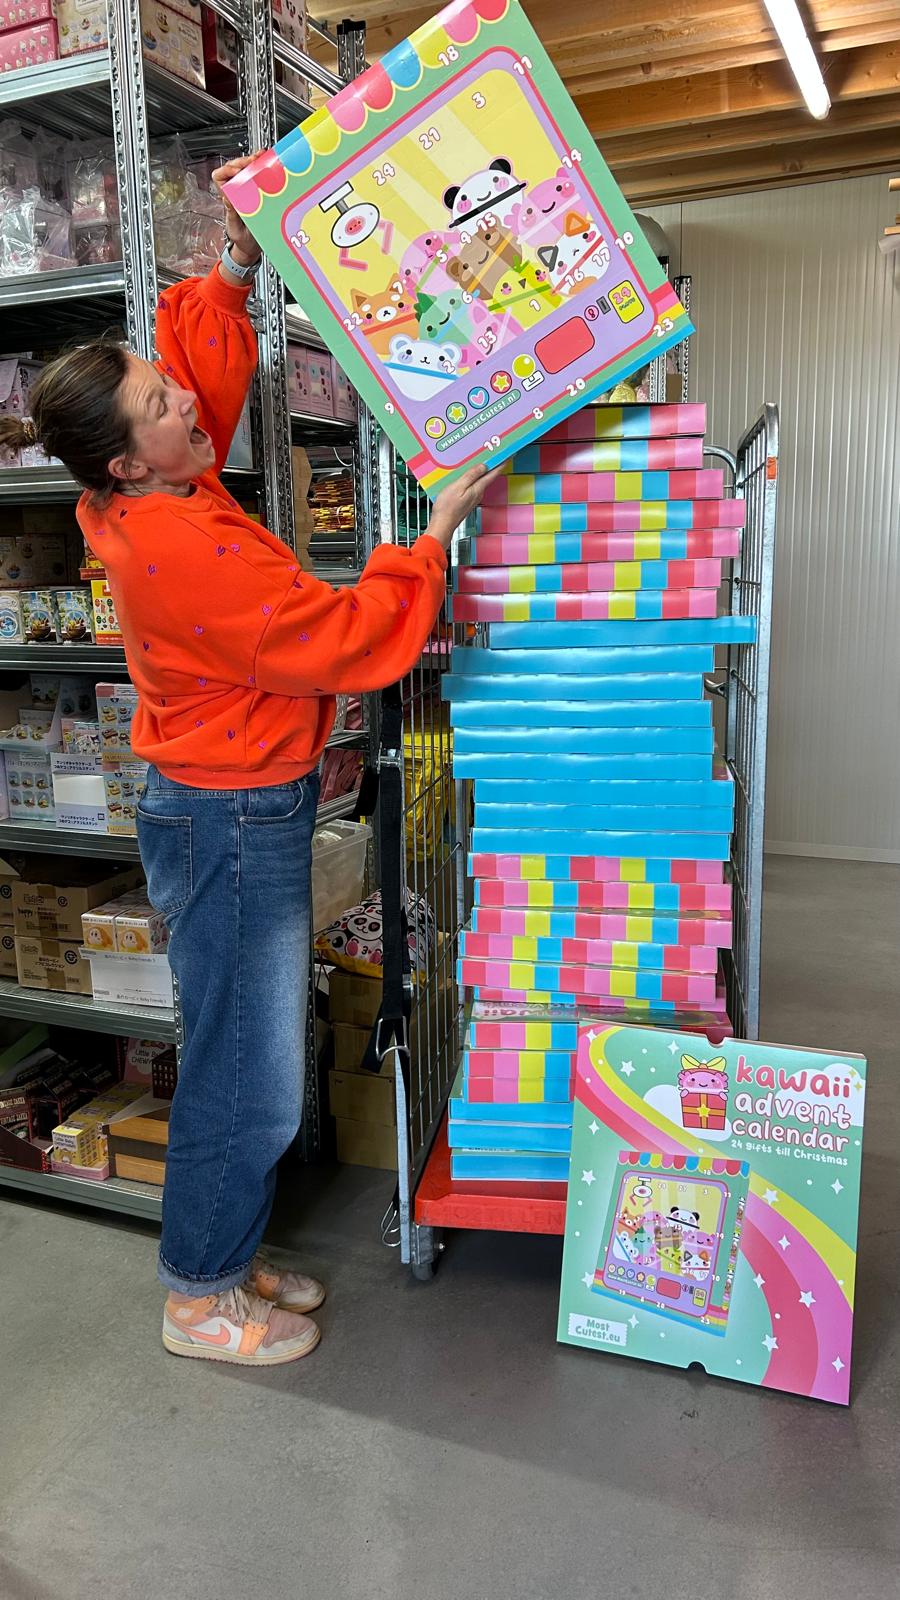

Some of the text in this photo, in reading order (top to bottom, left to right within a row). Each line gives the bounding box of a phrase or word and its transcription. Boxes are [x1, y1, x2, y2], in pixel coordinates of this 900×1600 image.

[438, 44, 460, 66] 18
[513, 56, 533, 76] 11
[472, 92, 486, 109] 3
[419, 127, 441, 150] 21
[562, 149, 583, 169] 14
[373, 163, 396, 186] 24
[476, 212, 497, 231] 15
[291, 230, 310, 249] 12
[615, 232, 634, 249] 10
[436, 249, 448, 263] 5
[592, 246, 611, 267] 17
[564, 270, 585, 290] 16
[462, 291, 474, 304] 6
[612, 286, 631, 305] 24
[343, 312, 364, 332] 22
[653, 318, 674, 337] 23
[477, 330, 498, 349] 13
[442, 361, 456, 374] 2
[566, 378, 586, 397] 20
[384, 401, 395, 415] 9
[532, 407, 544, 419] 8
[440, 393, 517, 449] www.MostCutest.nl
[484, 435, 501, 452] 19
[736, 1055, 851, 1098] kawaii
[734, 1092, 852, 1130] advent
[732, 1119, 850, 1152] calendar
[731, 1140, 848, 1166] 24 gifts till Christmas
[575, 1325, 620, 1342] Cutest.eu
[587, 1319, 610, 1331] Most
